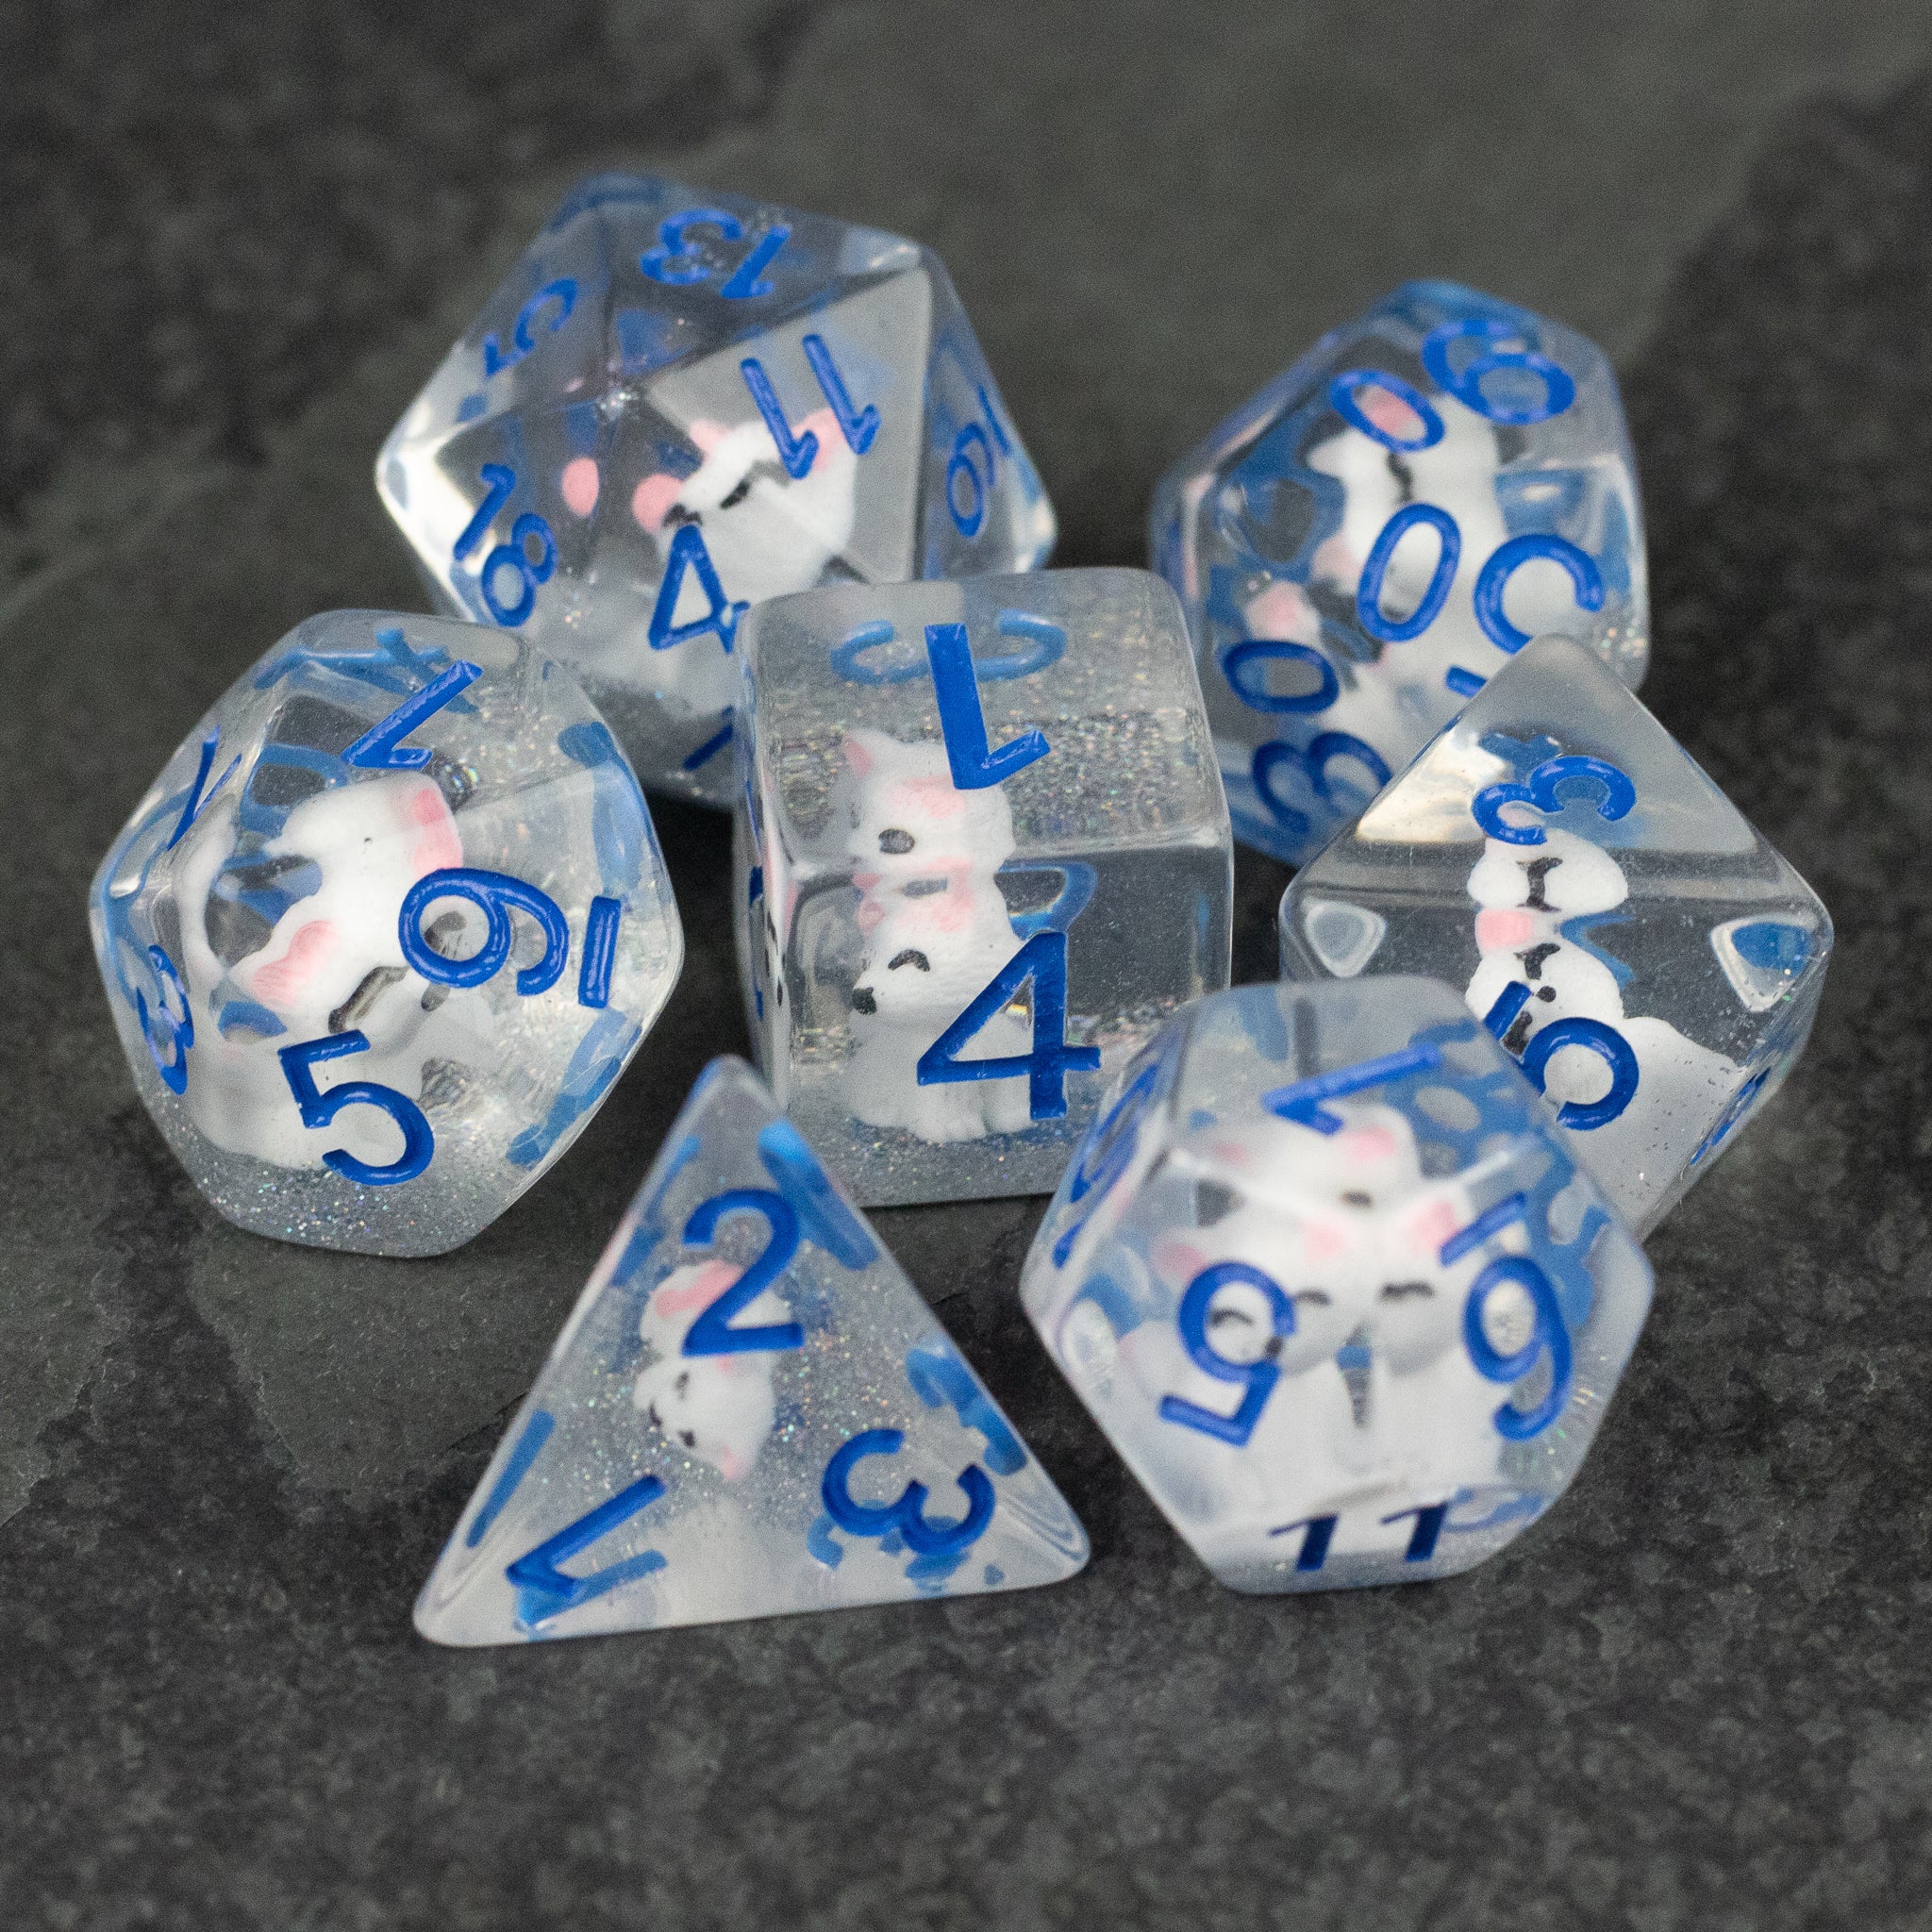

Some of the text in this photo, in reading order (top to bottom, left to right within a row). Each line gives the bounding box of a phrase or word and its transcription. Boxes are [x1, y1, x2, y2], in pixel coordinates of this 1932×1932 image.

[640, 208, 791, 299] 13
[740, 333, 882, 480] 11
[453, 463, 558, 627] 18
[647, 525, 751, 655] 4
[924, 623, 1050, 791] 1
[1471, 756, 1637, 846] 3
[916, 931, 1102, 1121] 4
[277, 1029, 435, 1187] 5
[682, 1188, 804, 1358] 2
[1159, 1261, 1298, 1448] 5
[505, 1474, 667, 1599] 1
[822, 1428, 996, 1557] 3
[1269, 1499, 1450, 1572] 11
